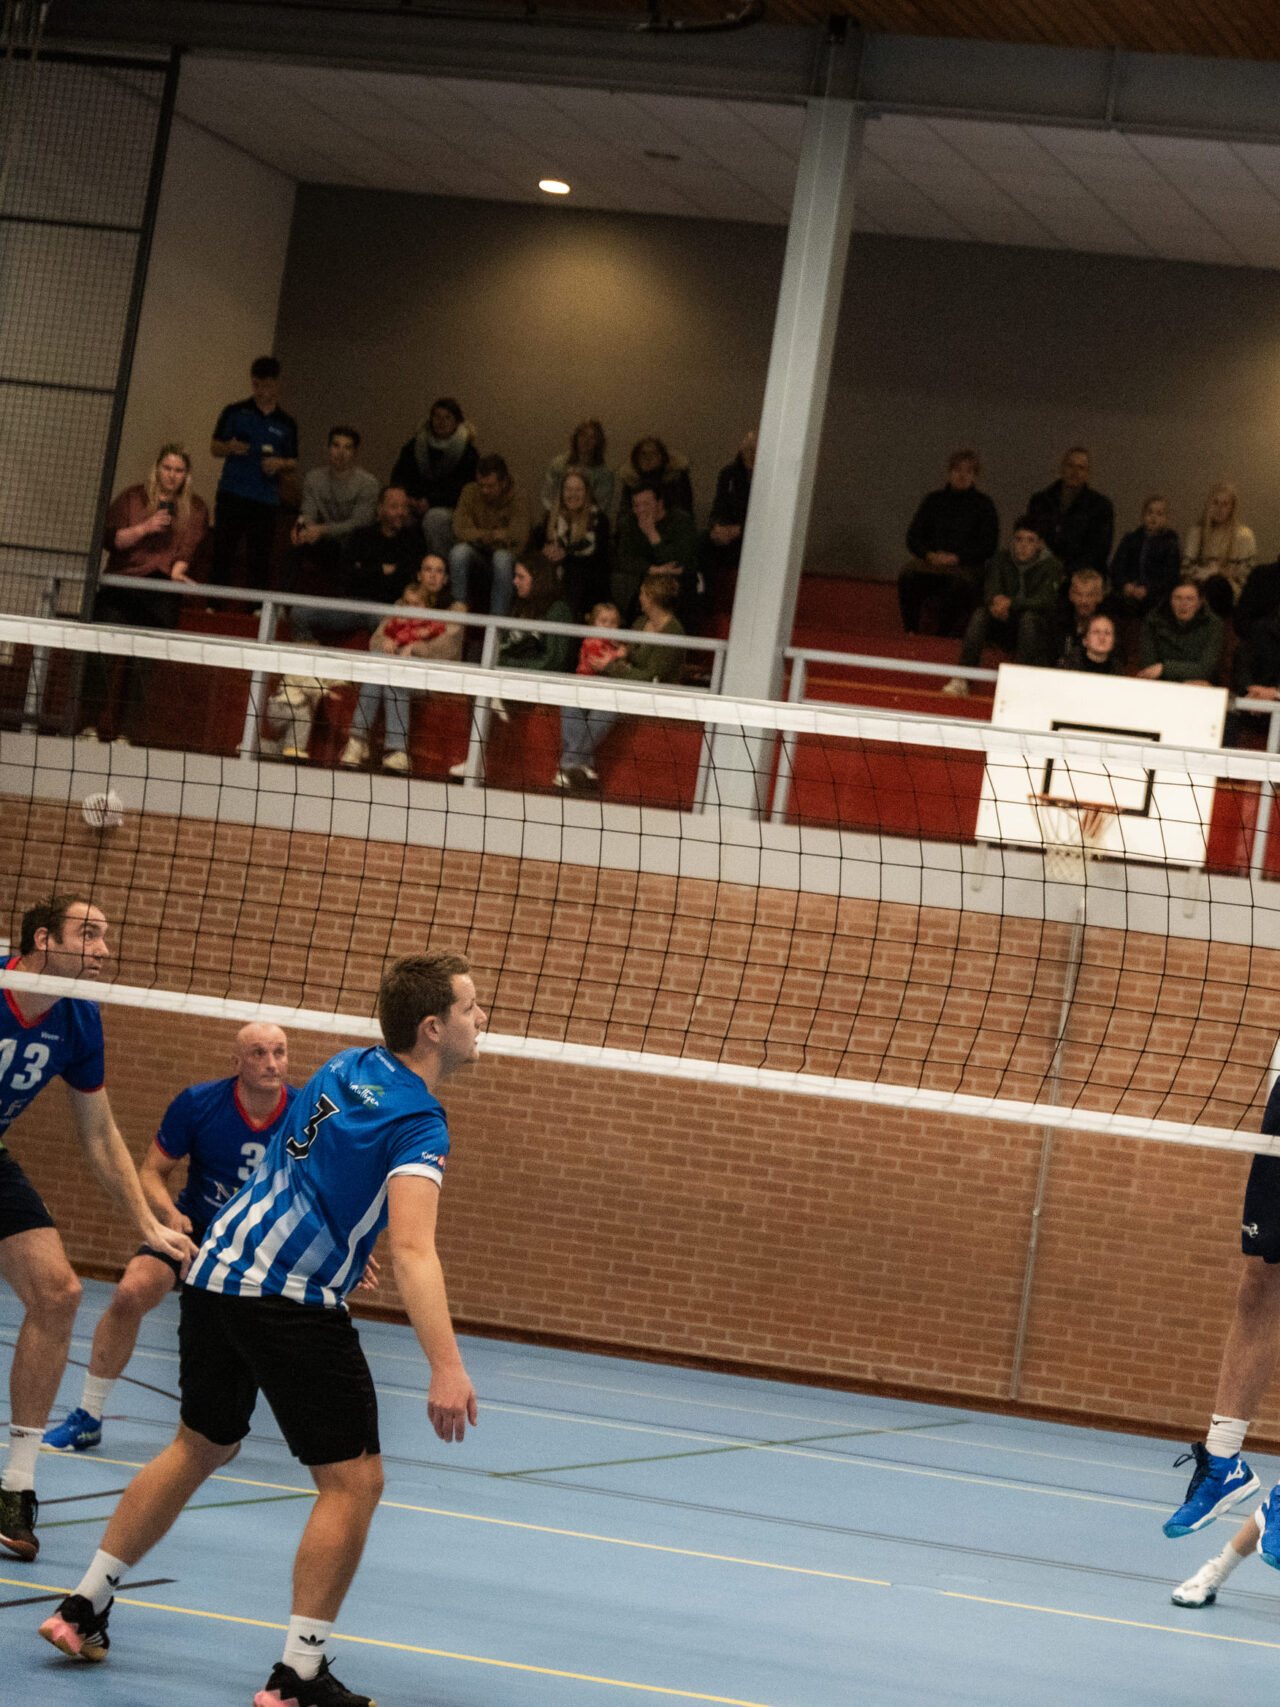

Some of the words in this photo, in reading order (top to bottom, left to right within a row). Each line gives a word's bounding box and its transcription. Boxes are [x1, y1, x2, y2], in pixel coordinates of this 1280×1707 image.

[0, 1038, 50, 1090] 13
[285, 1092, 340, 1160] 3
[237, 1142, 267, 1181] 3
